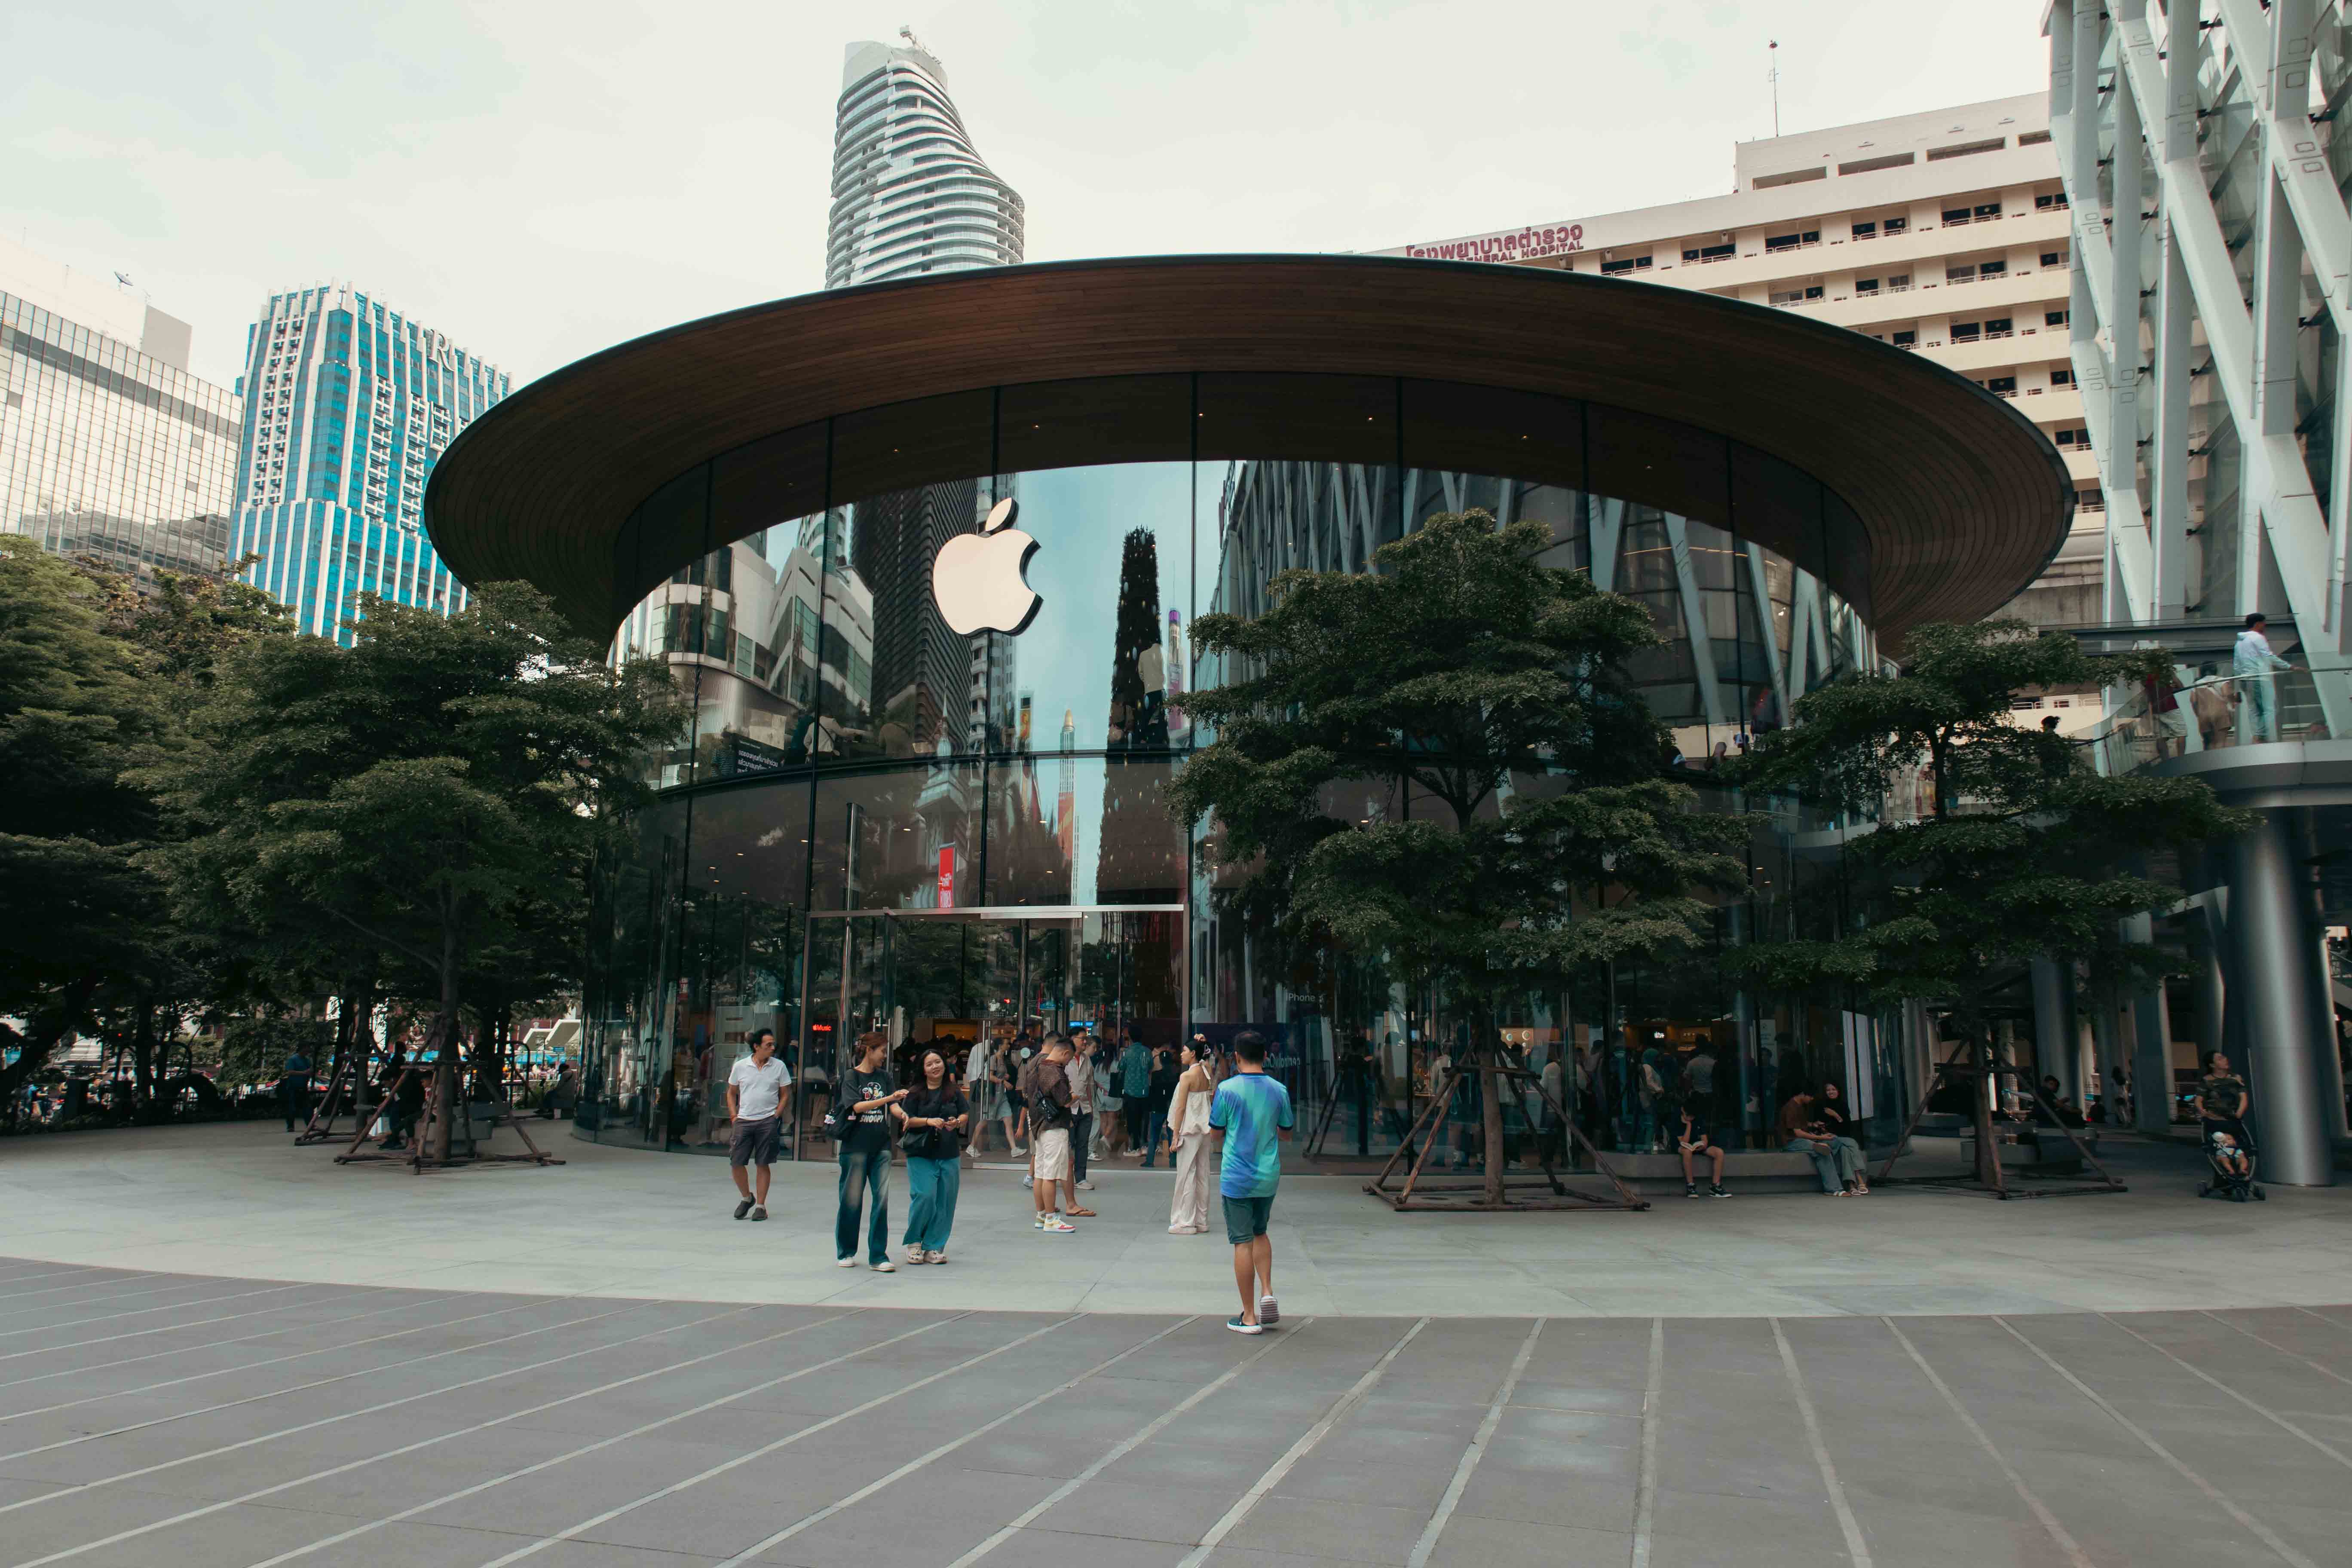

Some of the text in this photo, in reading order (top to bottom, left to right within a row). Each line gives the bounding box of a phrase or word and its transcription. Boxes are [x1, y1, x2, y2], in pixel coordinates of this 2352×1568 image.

[1458, 241, 1584, 263] NERAL HOSPITAL
[1286, 992, 1315, 1001] iPhone
[860, 1115, 884, 1123] SNOOPY
